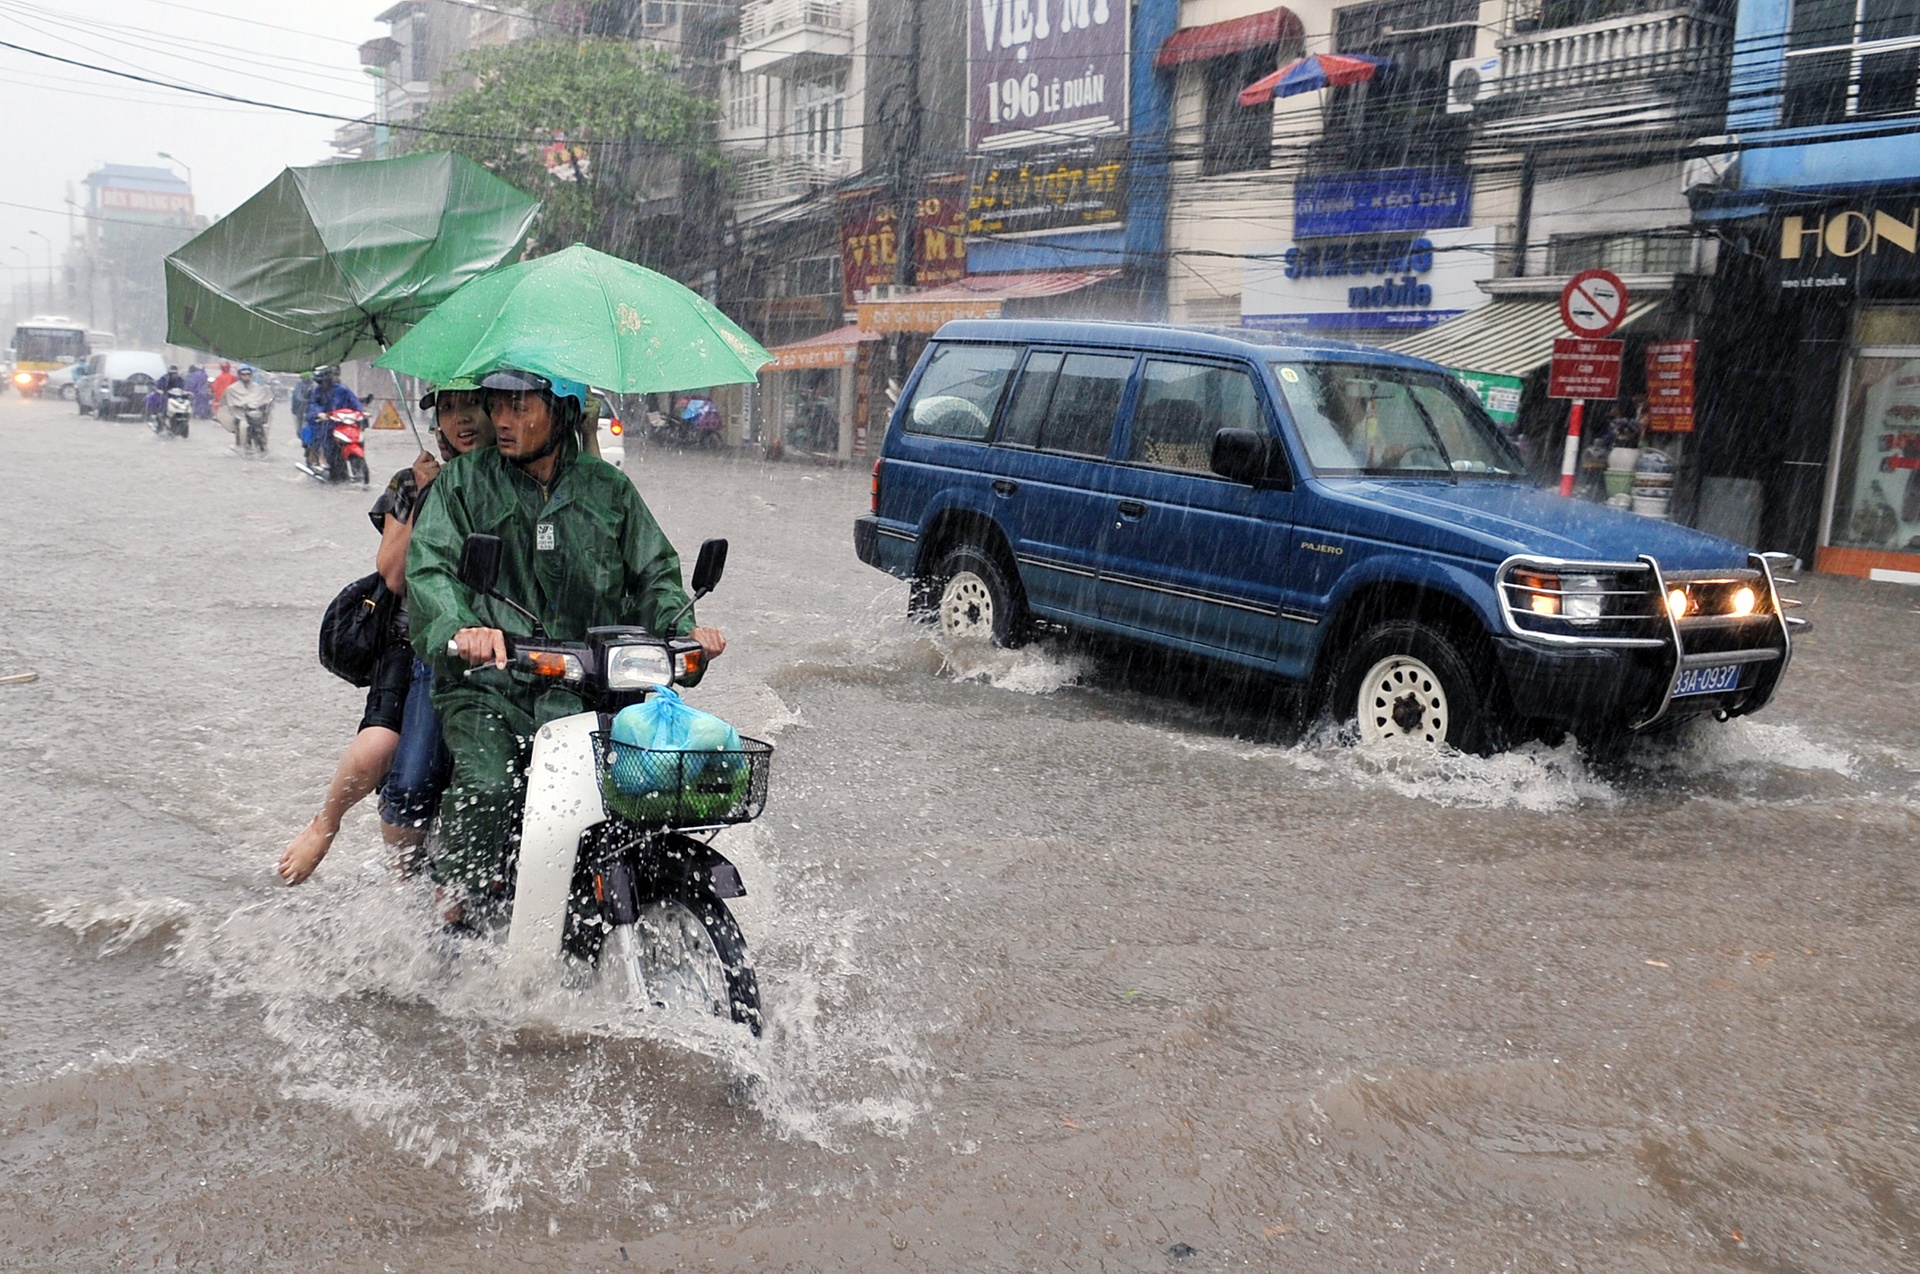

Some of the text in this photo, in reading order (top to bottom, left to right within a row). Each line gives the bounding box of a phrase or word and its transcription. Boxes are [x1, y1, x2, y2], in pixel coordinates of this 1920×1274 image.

[987, 64, 1105, 123] 196 LÊ DUẨN
[1348, 276, 1432, 308] mobile
[1301, 541, 1344, 555] PAJERO
